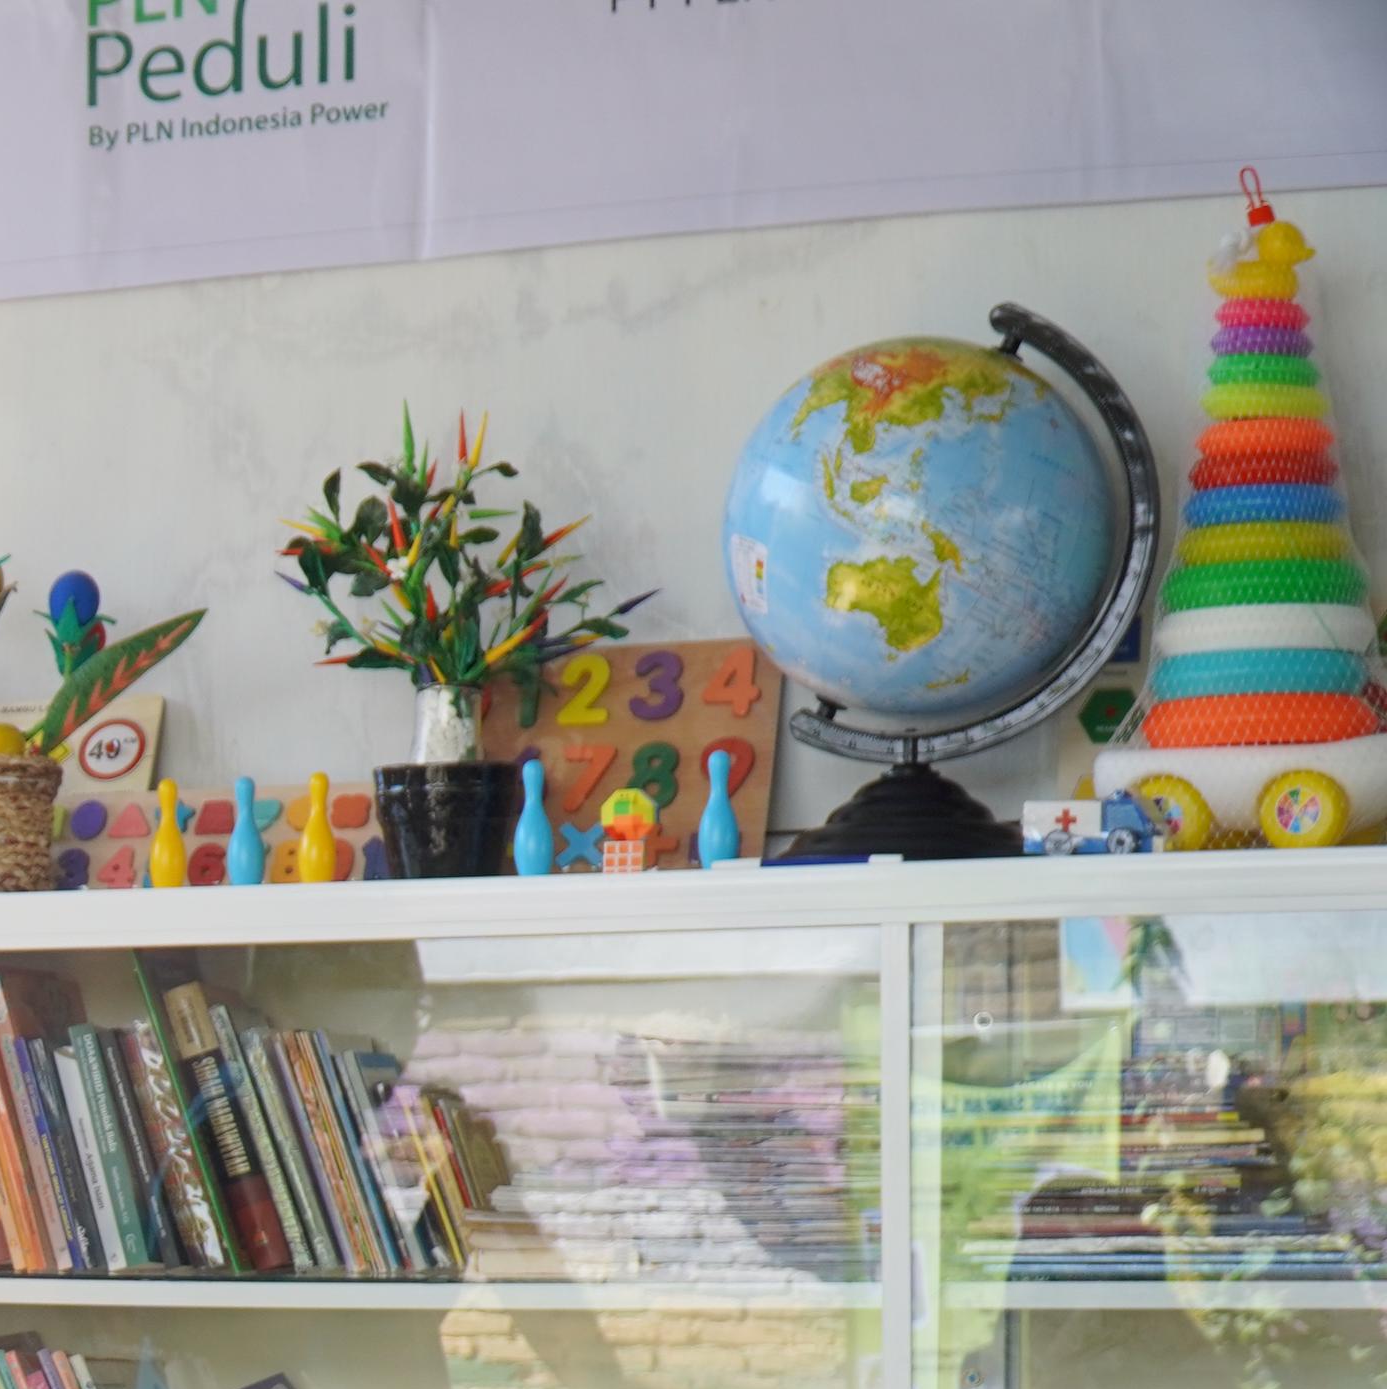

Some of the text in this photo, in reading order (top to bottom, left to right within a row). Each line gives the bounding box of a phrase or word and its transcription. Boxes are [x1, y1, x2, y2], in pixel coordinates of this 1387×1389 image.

[86, 0, 358, 108] Peduli
[88, 100, 389, 151] By PLN Indonesia Power
[555, 654, 612, 726] 2
[629, 650, 685, 722] 3
[701, 645, 762, 719] 4
[563, 743, 618, 813] 7
[82, 1151, 99, 1184] Agama
[92, 1185, 106, 1209] Islam
